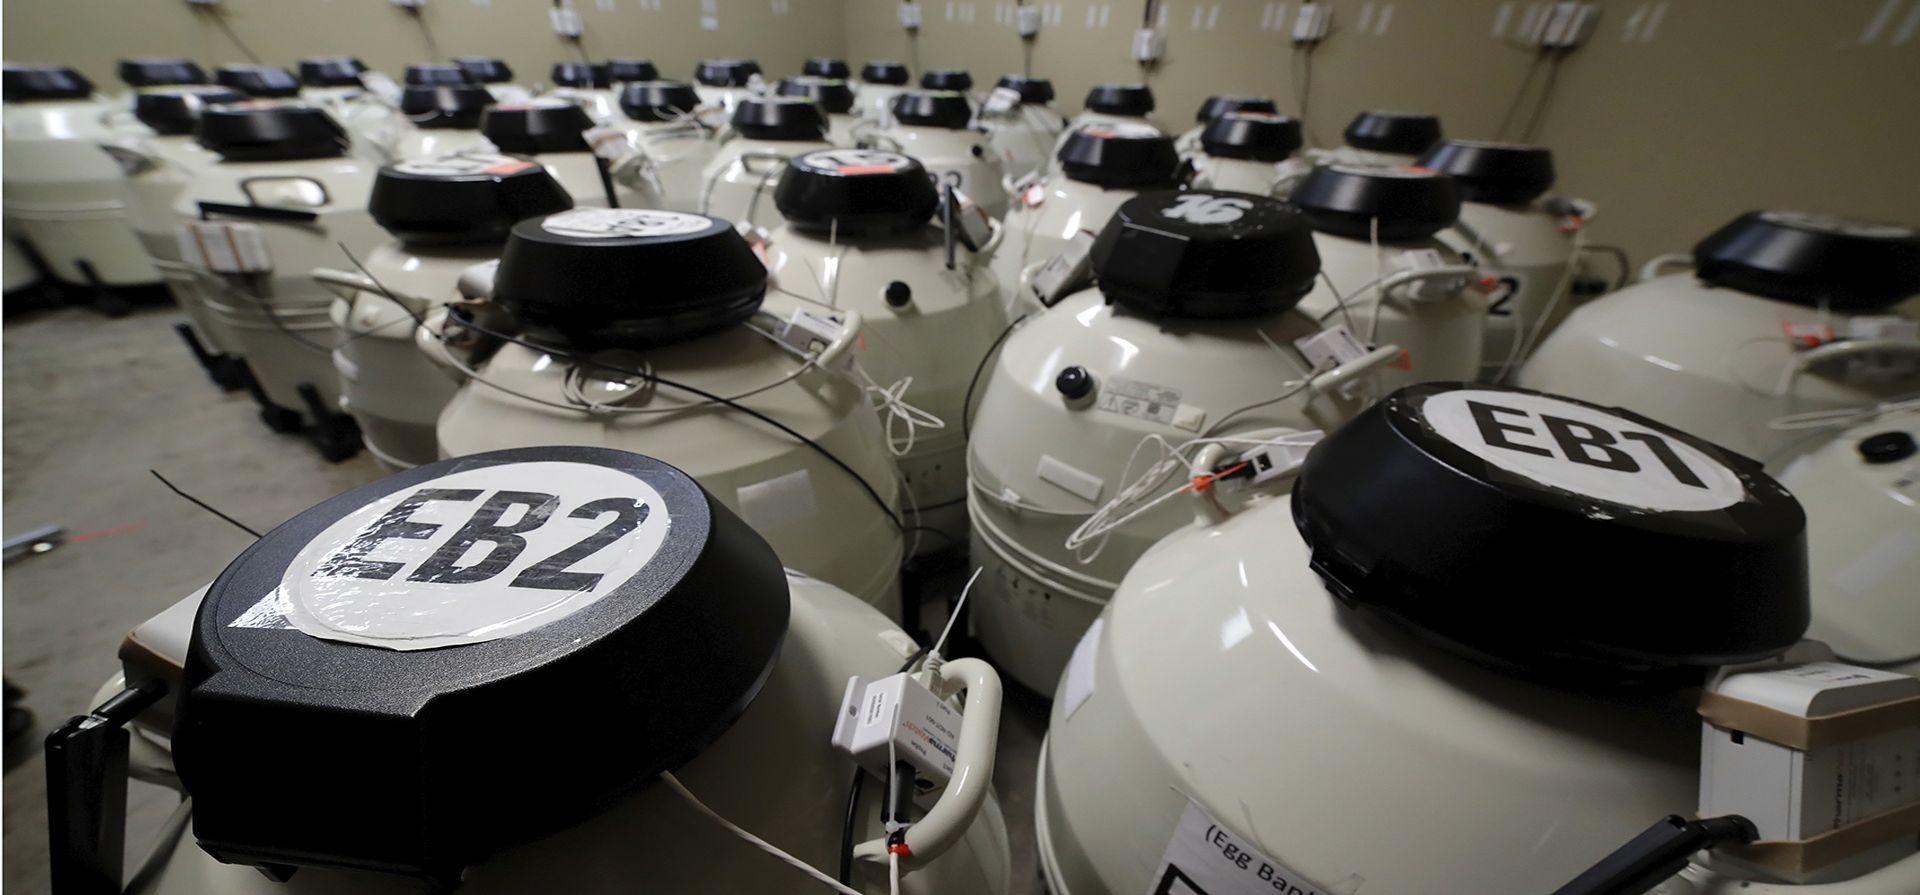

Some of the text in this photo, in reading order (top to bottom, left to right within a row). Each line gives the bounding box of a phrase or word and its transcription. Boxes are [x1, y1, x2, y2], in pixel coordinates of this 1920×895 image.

[1160, 194, 1254, 224] 16
[1466, 400, 1710, 490] EB1
[311, 488, 650, 592] EB2
[1205, 824, 1252, 870] (Egg
[1256, 862, 1315, 895] Ban
